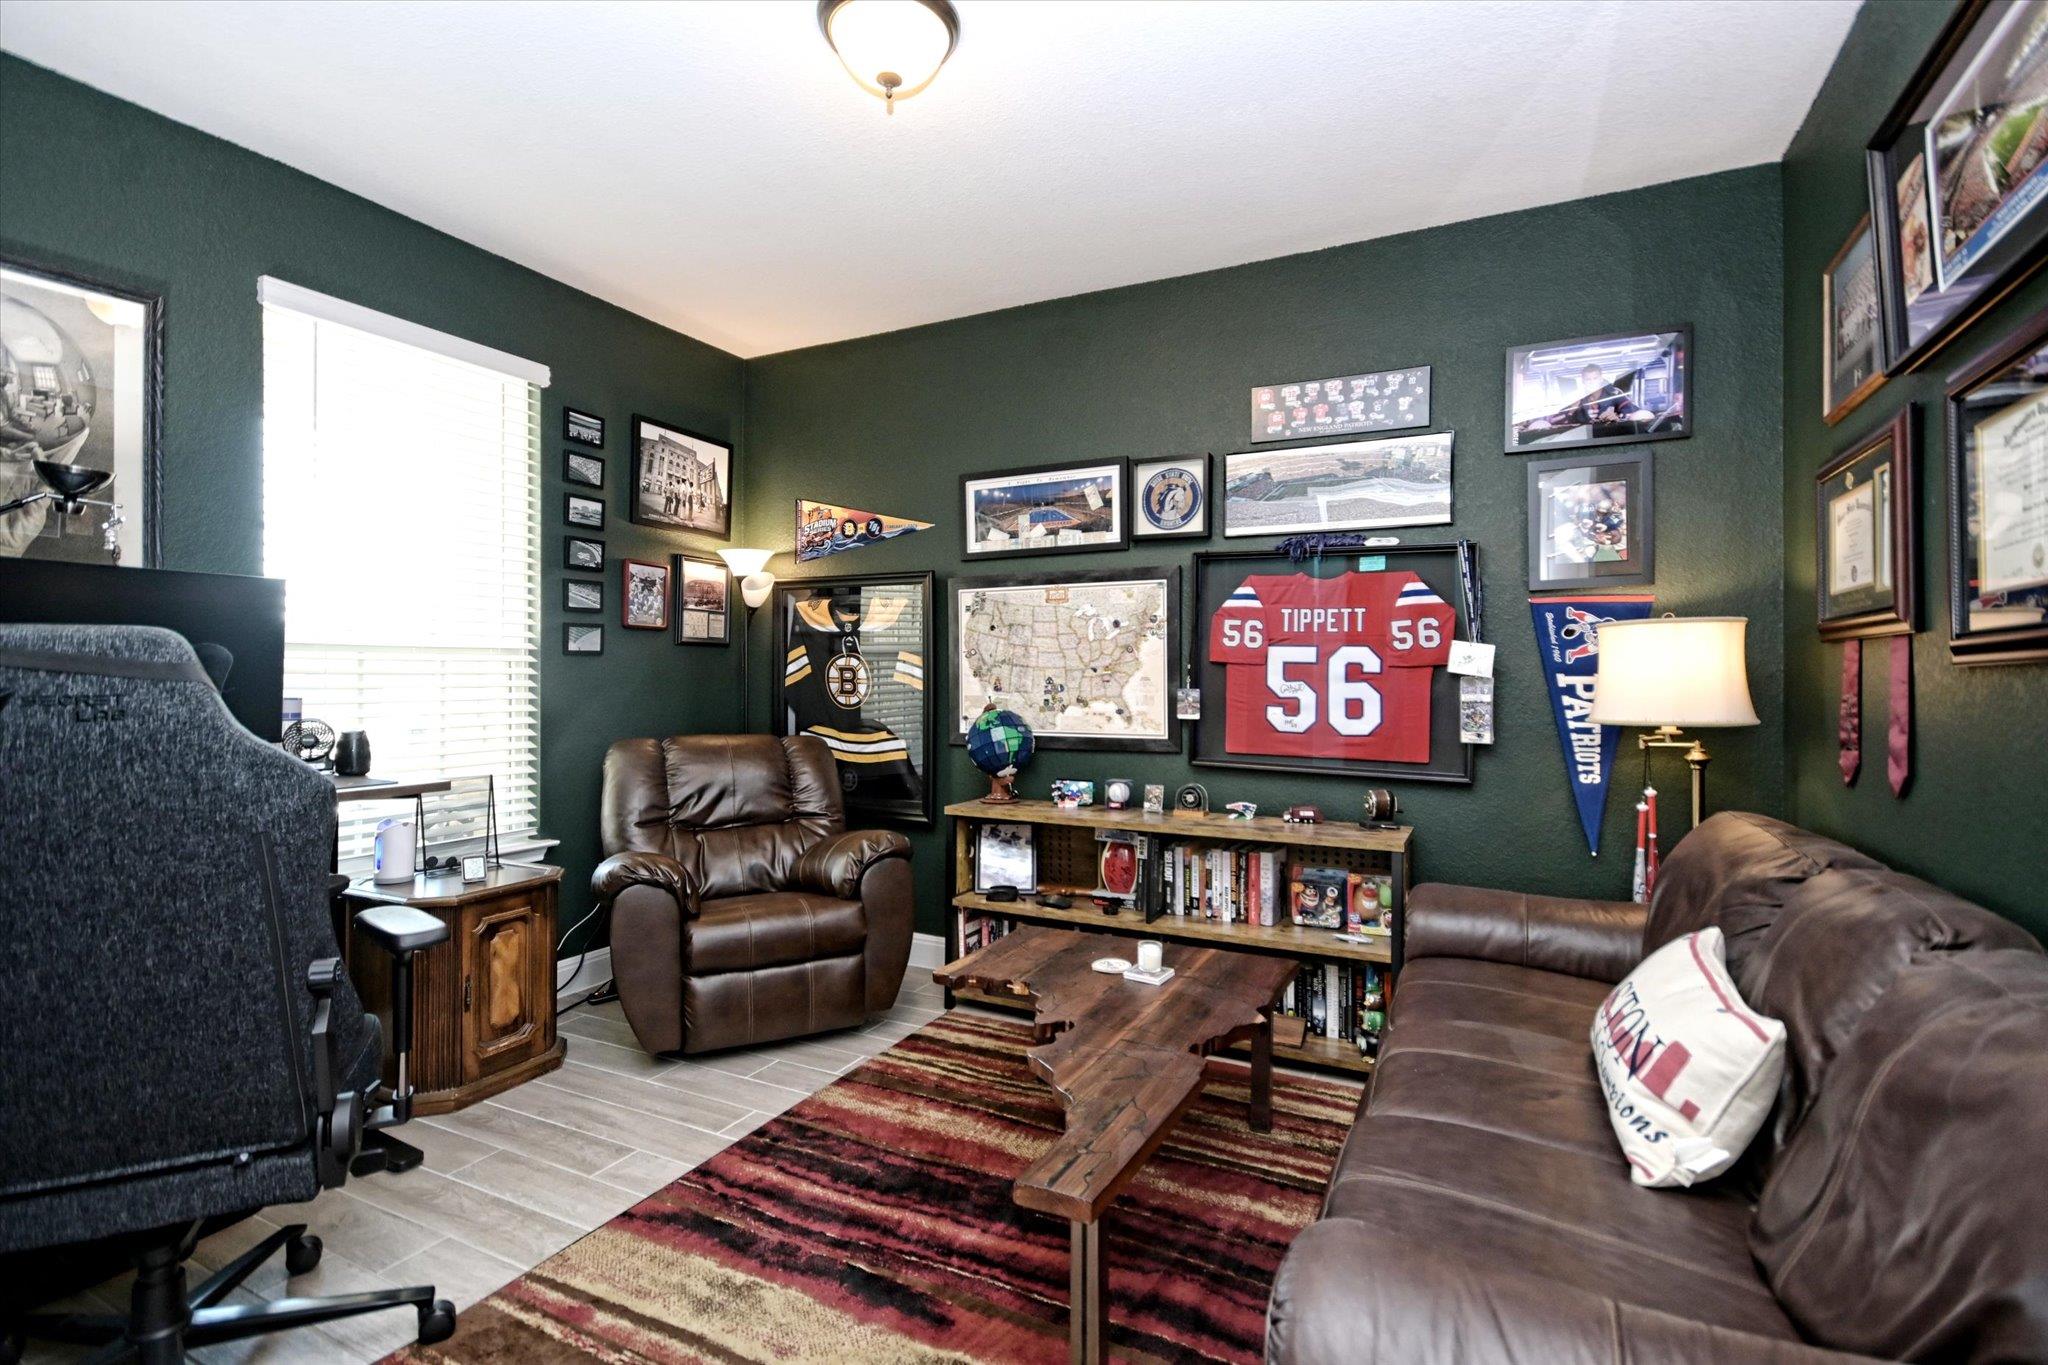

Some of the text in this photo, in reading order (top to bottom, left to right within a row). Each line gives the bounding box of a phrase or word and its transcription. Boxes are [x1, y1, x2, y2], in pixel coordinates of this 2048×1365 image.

[1314, 423, 1343, 432] ENGLAND
[1344, 420, 1373, 429] PATRIOTS
[804, 519, 837, 534] STADIUM
[1222, 618, 1264, 649] 56
[1281, 607, 1366, 633] TIPPETT
[1390, 617, 1442, 650] 56
[1551, 644, 1562, 663] 1960
[838, 665, 858, 697] B
[1265, 645, 1383, 737] 56
[1556, 673, 1602, 785] PATRIOTS
[1164, 850, 1173, 883] SELLOUT
